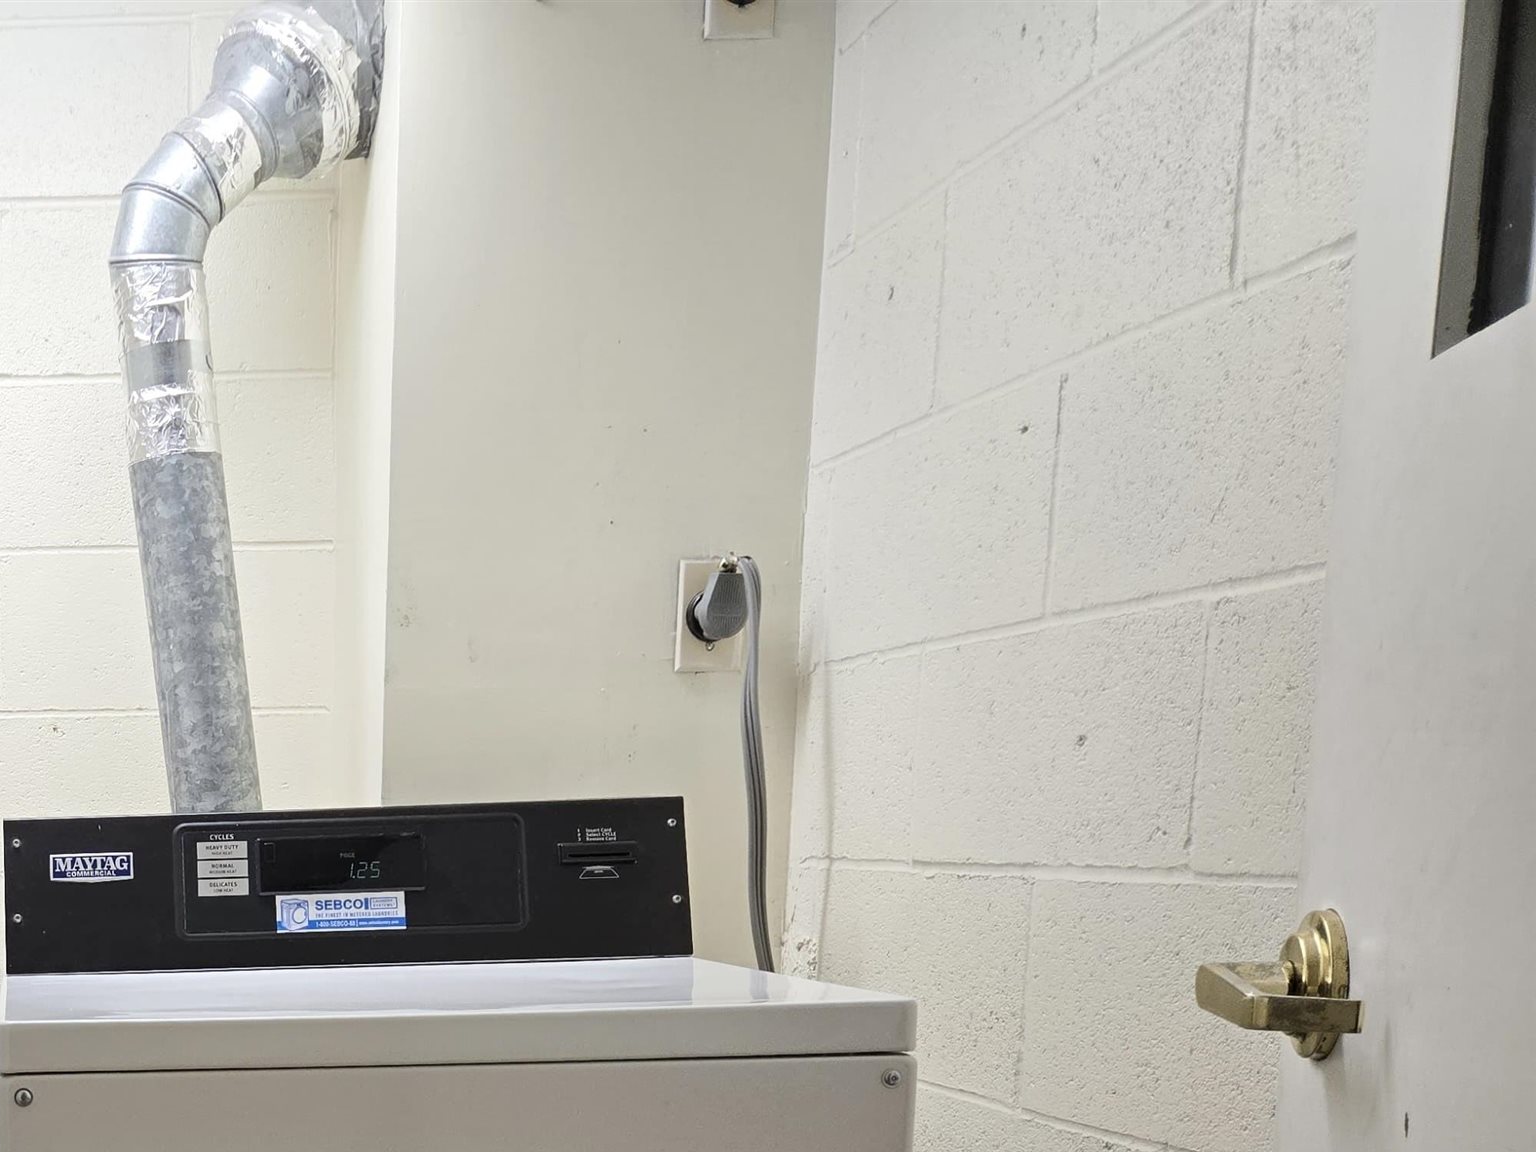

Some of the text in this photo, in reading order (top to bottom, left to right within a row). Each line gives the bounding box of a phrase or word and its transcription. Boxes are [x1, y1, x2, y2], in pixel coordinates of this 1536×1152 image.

[54, 856, 128, 872] MAYTAG
[350, 861, 381, 878] 1.25
[315, 898, 364, 910] SEBCO
